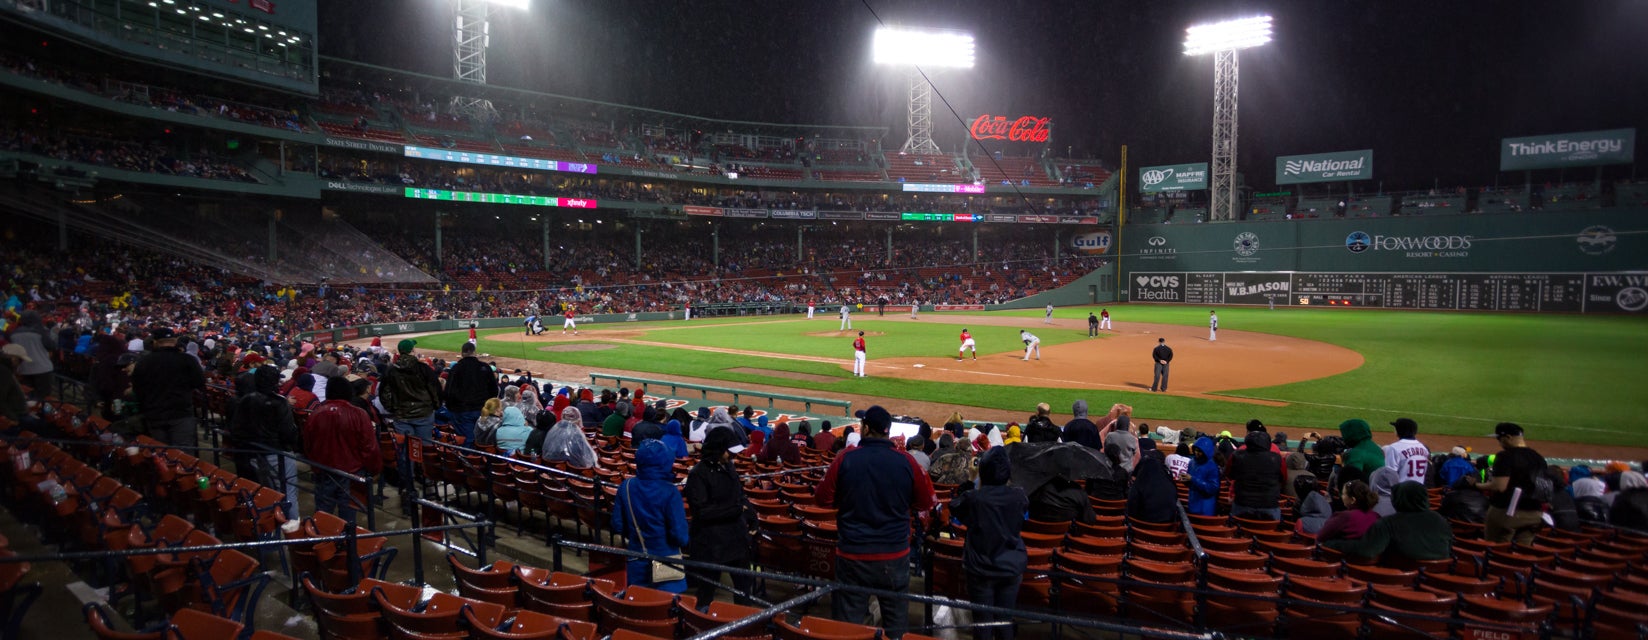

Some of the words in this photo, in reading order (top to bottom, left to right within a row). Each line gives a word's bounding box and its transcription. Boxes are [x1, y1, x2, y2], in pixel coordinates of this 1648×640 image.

[970, 114, 1051, 142] Coca-Cola
[326, 138, 345, 146] STATE
[346, 140, 367, 149] STREET
[369, 143, 397, 152] PAVILION
[1302, 156, 1364, 173] National
[1144, 170, 1163, 184] AAA
[346, 184, 382, 192] Technologies
[567, 199, 586, 208] xfinity
[1074, 234, 1110, 247] Gulf
[1374, 235, 1471, 250] FOXWOODS
[1150, 276, 1179, 287] CVS
[1593, 276, 1623, 287] F.W.
[1138, 288, 1178, 300] Health
[1407, 460, 1426, 477] 15
[810, 559, 830, 572] 20
[1473, 630, 1510, 640] FIELD
